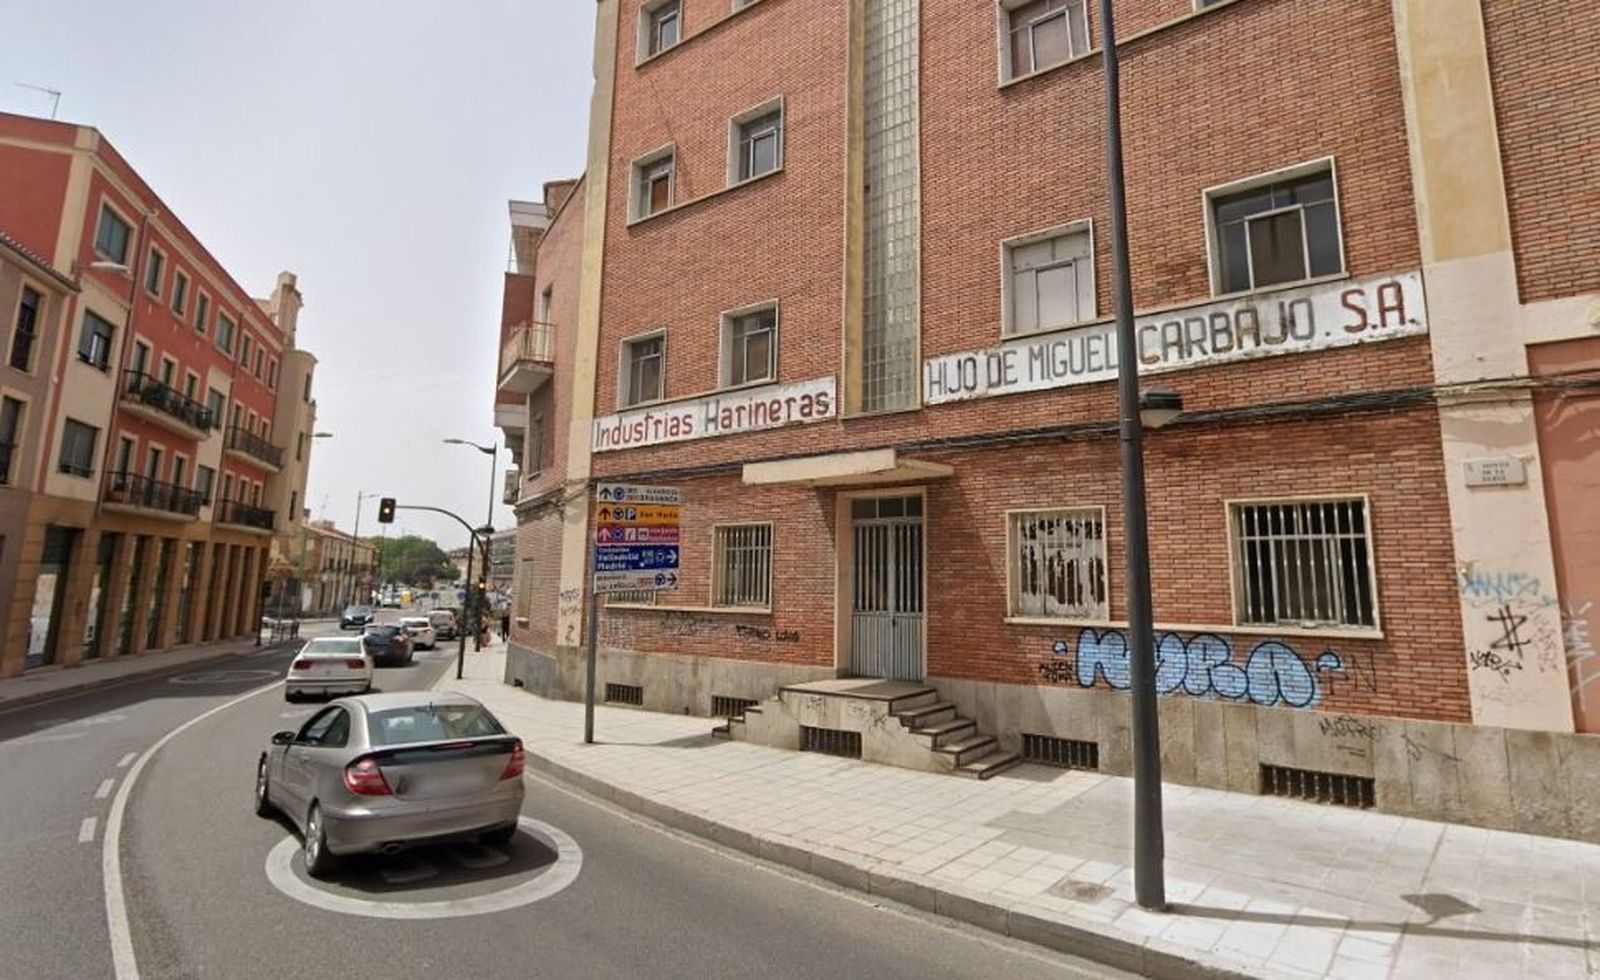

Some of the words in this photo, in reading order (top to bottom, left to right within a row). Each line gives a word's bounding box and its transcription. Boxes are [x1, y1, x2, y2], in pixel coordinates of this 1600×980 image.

[927, 356, 978, 397] HIJO
[986, 350, 1018, 388] DE
[1028, 331, 1118, 382] MIGUEL
[1340, 281, 1419, 334] S.A.
[595, 413, 693, 447] Industrias
[705, 390, 830, 433] Harineras
